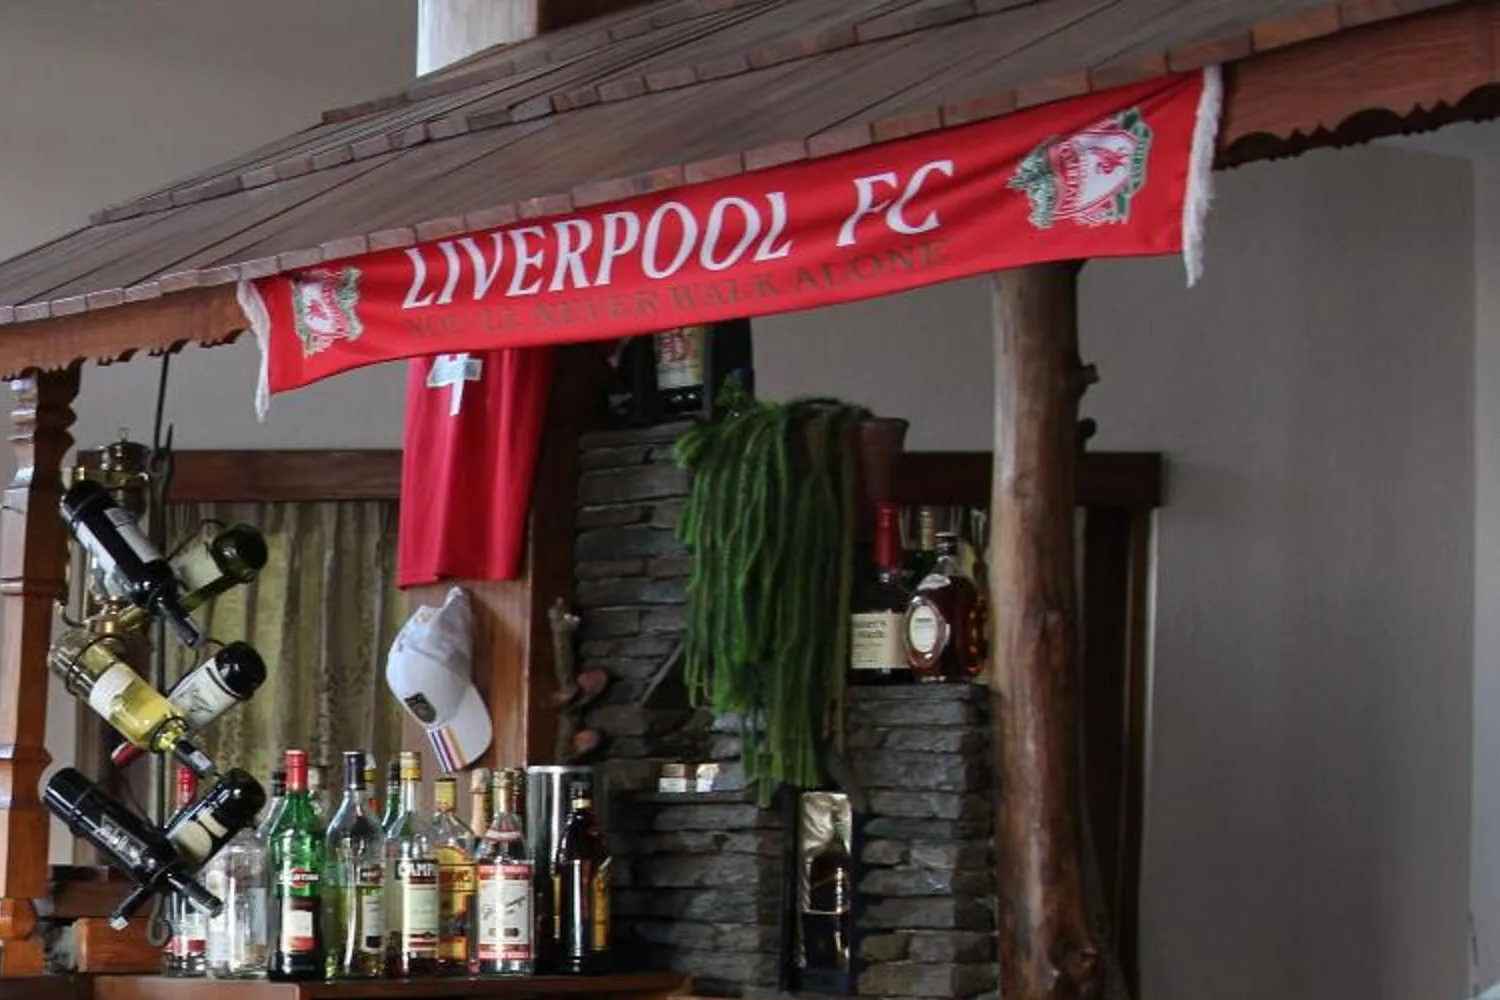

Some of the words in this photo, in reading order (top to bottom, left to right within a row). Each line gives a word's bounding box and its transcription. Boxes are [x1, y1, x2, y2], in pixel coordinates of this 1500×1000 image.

[402, 192, 793, 310] LIVERPOOL
[836, 160, 954, 247] FC
[533, 288, 658, 325] NEVER
[668, 271, 779, 309] WALK
[793, 239, 946, 289] ALONE
